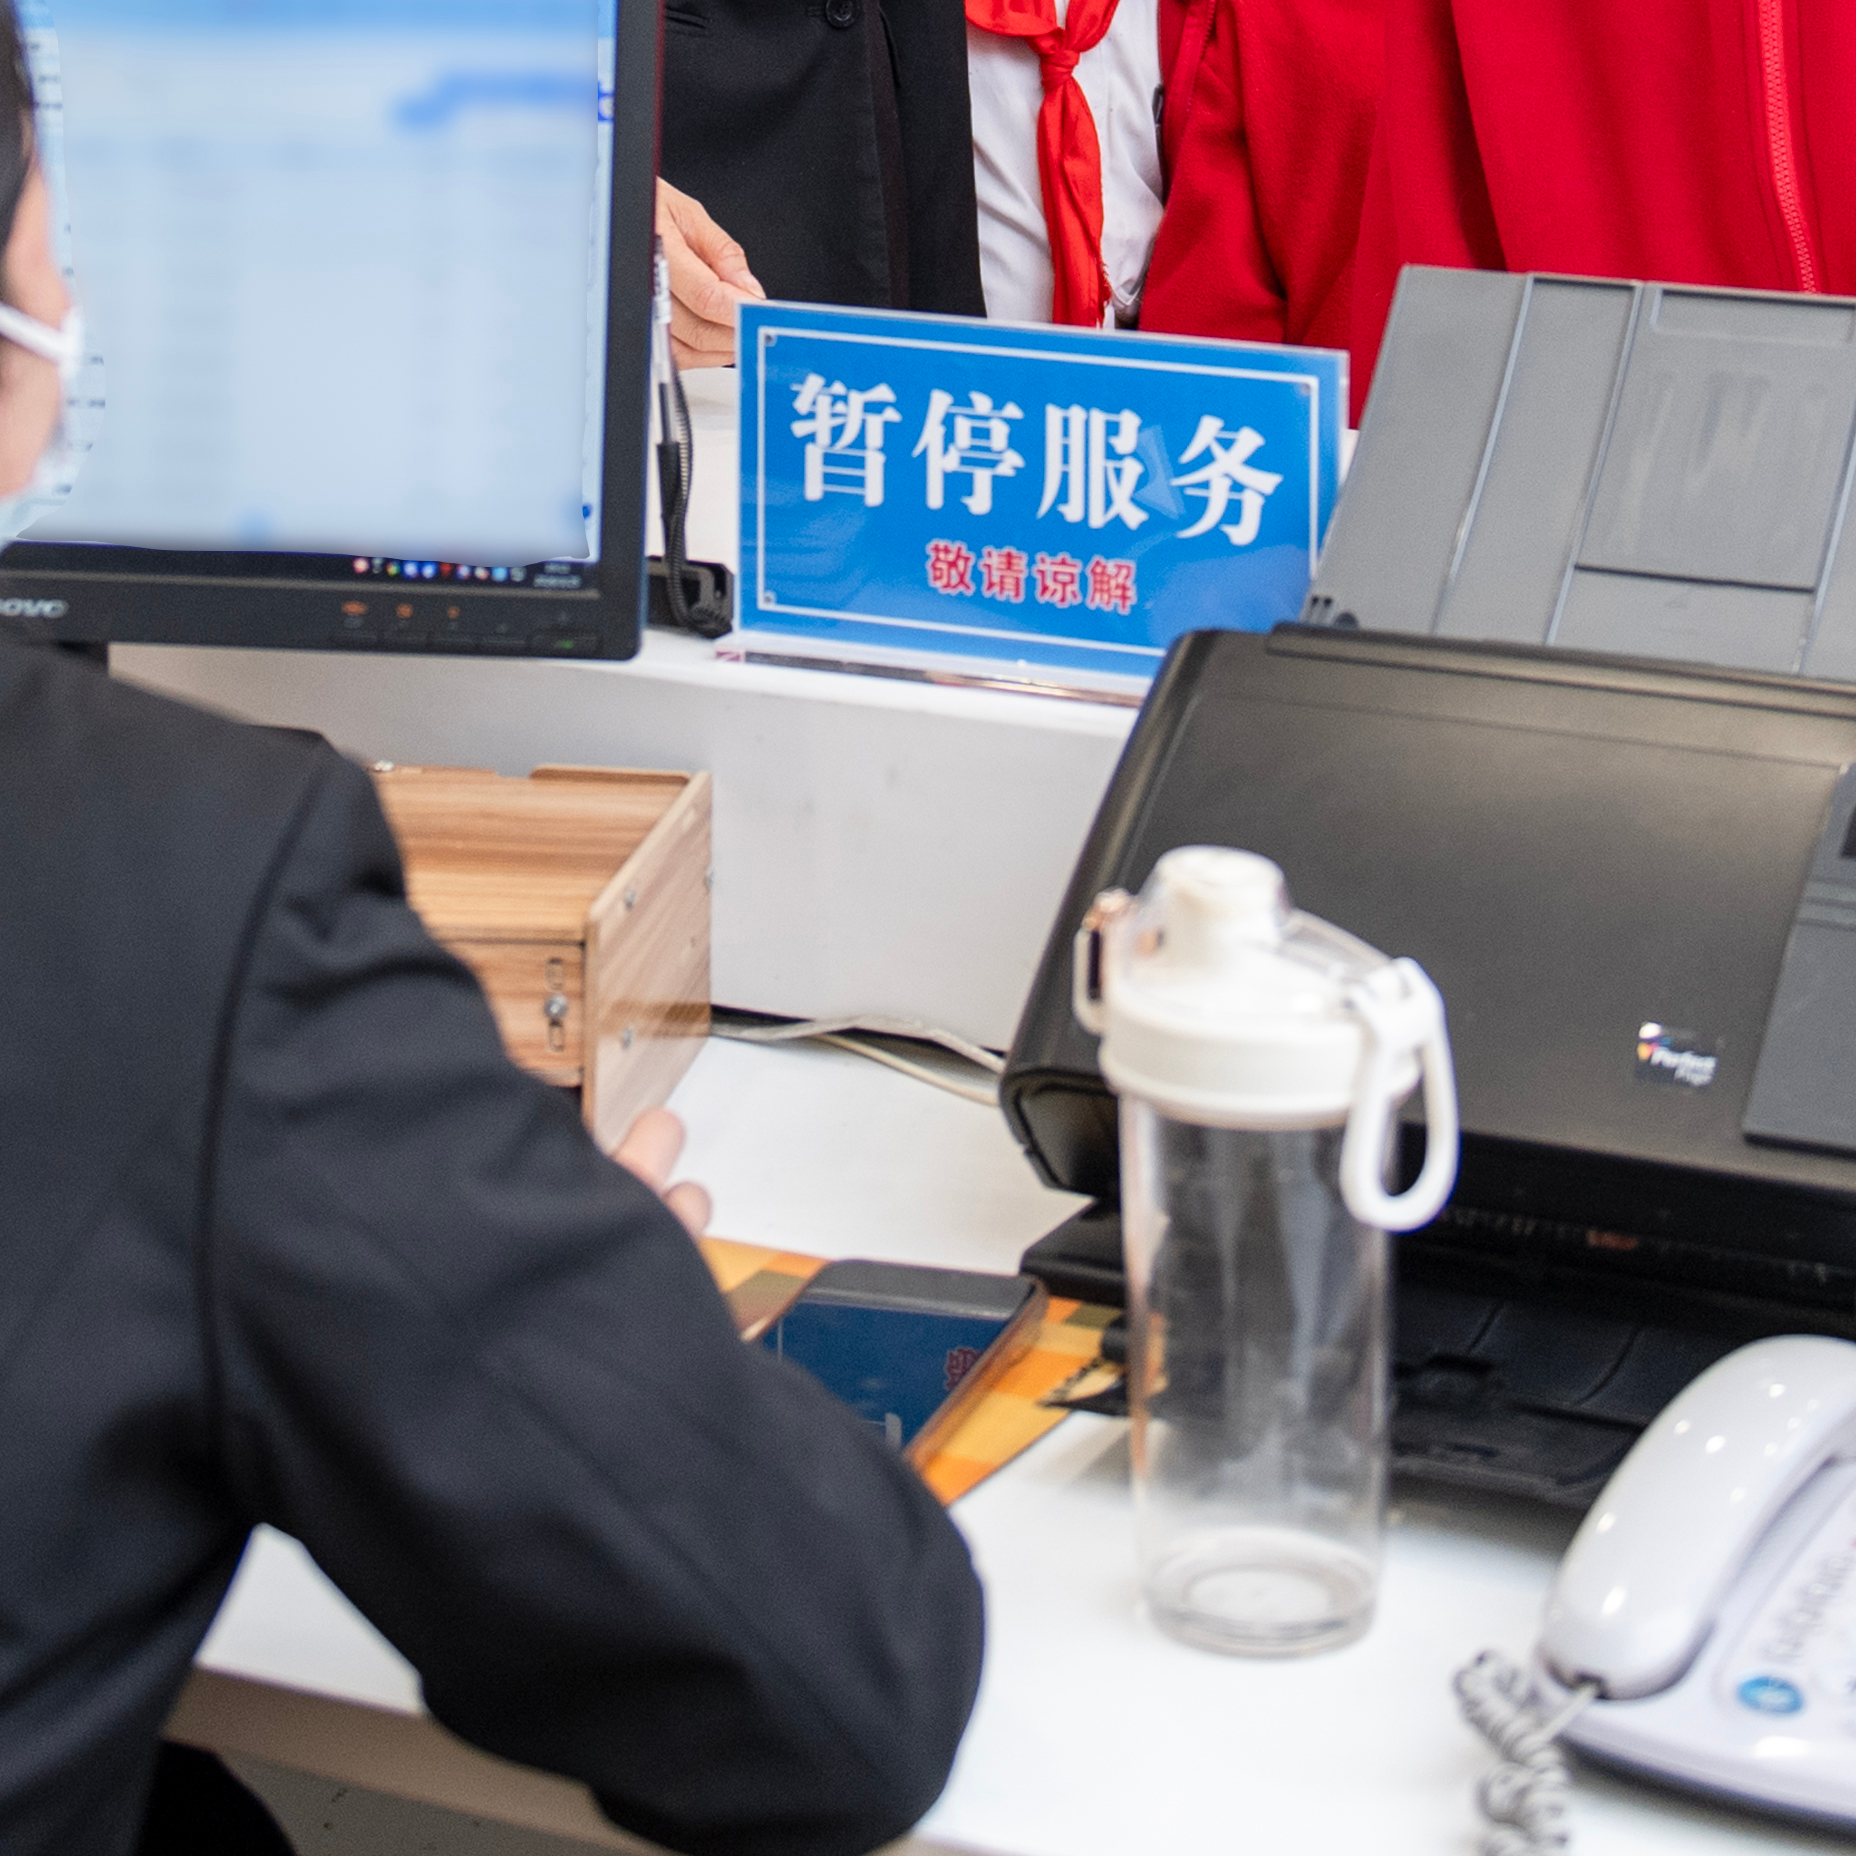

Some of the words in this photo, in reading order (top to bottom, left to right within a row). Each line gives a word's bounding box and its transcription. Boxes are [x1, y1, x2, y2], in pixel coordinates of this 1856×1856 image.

[789, 373, 1284, 546] 暂停服务
[926, 538, 1139, 615] 敬请谅解
